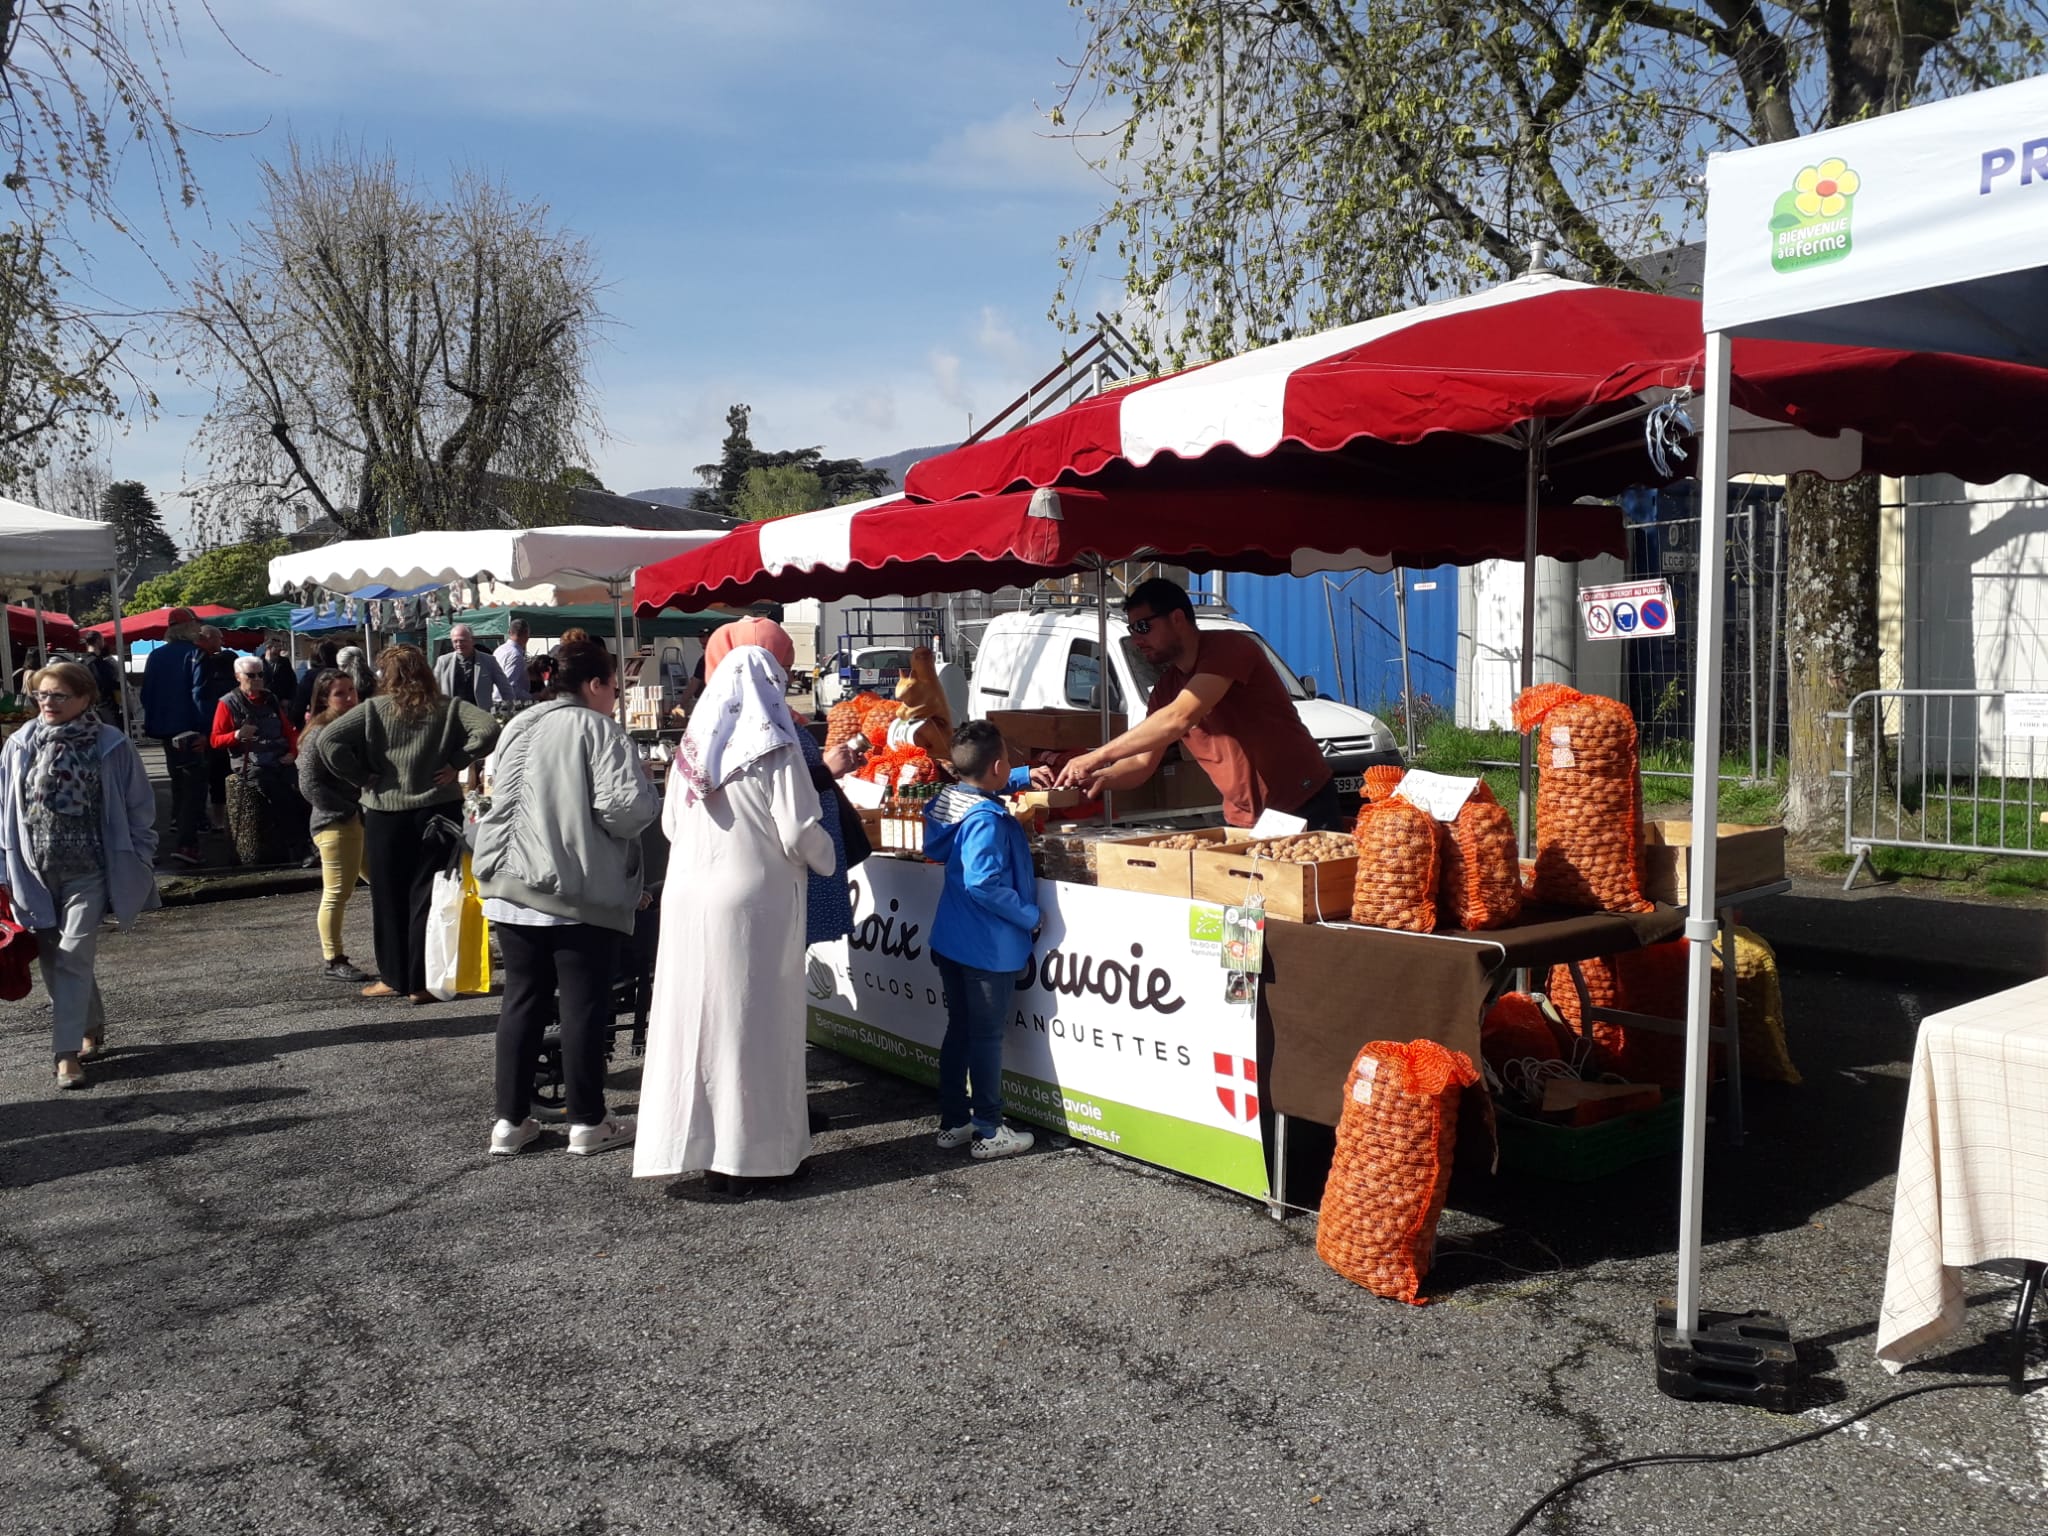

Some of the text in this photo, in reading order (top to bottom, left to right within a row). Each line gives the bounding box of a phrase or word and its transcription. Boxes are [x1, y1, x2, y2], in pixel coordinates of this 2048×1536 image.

[1778, 217, 1848, 245] BIENVENUE
[1785, 246, 1795, 258] la
[1796, 234, 1847, 258] ferme
[1643, 585, 1665, 594] PUBLIC
[835, 962, 1191, 1066] LE CLOS DE ANQUETTES
[815, 1012, 859, 1040] Benjamin
[859, 1027, 907, 1057] SAUDINO
[1002, 1079, 1030, 1098] noix
[1031, 1085, 1050, 1105] de
[1051, 1090, 1103, 1121] Savoie
